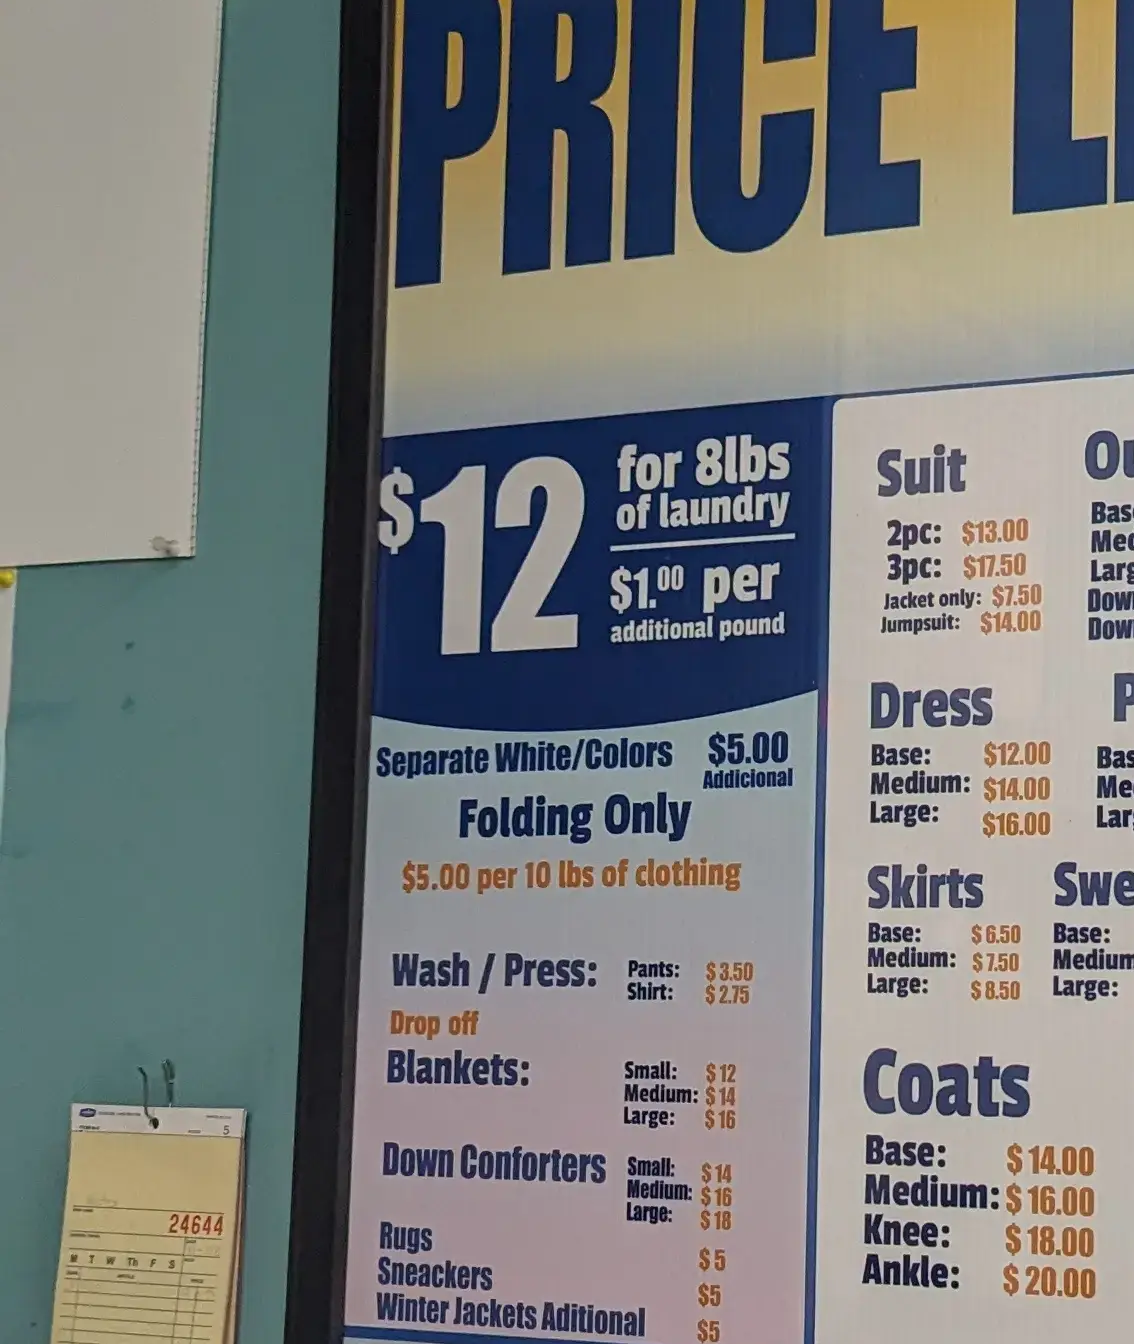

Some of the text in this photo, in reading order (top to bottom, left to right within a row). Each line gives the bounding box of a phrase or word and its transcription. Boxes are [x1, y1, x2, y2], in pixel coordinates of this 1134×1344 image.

[617, 434, 790, 493] for 8lbs
[877, 444, 967, 498] Suit
[616, 487, 789, 532] of laundry
[886, 518, 1029, 549] 2pc: $13.00
[886, 553, 1026, 583] 3pc: $17.50
[610, 562, 780, 616] $1.00 per
[883, 583, 1043, 612] Jacket only: $7.50
[610, 612, 785, 644] additional pound
[880, 609, 1042, 636] Jumpsuit: $14.00
[869, 682, 994, 730] Dress
[376, 730, 789, 779] Separate White/Colors $5.00
[870, 741, 1052, 768] Base: $12.00
[702, 767, 793, 791] Addicional
[869, 771, 1051, 803] Medium: $14.00
[460, 791, 691, 844] Folding Only
[869, 799, 1052, 840] Large: $16.00
[402, 859, 742, 894] $5.00 per 10 lbs of clothing
[867, 864, 984, 911] Skirts
[392, 951, 598, 988] Wash Press:
[628, 959, 680, 980] Pants:
[627, 982, 673, 1002] Shirt:
[390, 1009, 479, 1041] Drop off
[387, 1050, 530, 1087] Blankets:
[863, 1047, 1031, 1119] Coats
[382, 1141, 607, 1184] Down Conforters
[865, 1134, 946, 1169] Base:
[864, 1174, 1000, 1210] Medium:
[168, 1213, 225, 1237] 24644
[379, 1221, 433, 1255] Rugs
[863, 1213, 951, 1249] Knee:
[377, 1256, 493, 1291] Sneackers
[861, 1253, 960, 1291] Ankle:
[376, 1292, 449, 1325] Winter
[453, 1301, 537, 1332] Jackets
[541, 1301, 646, 1338] Aditional
